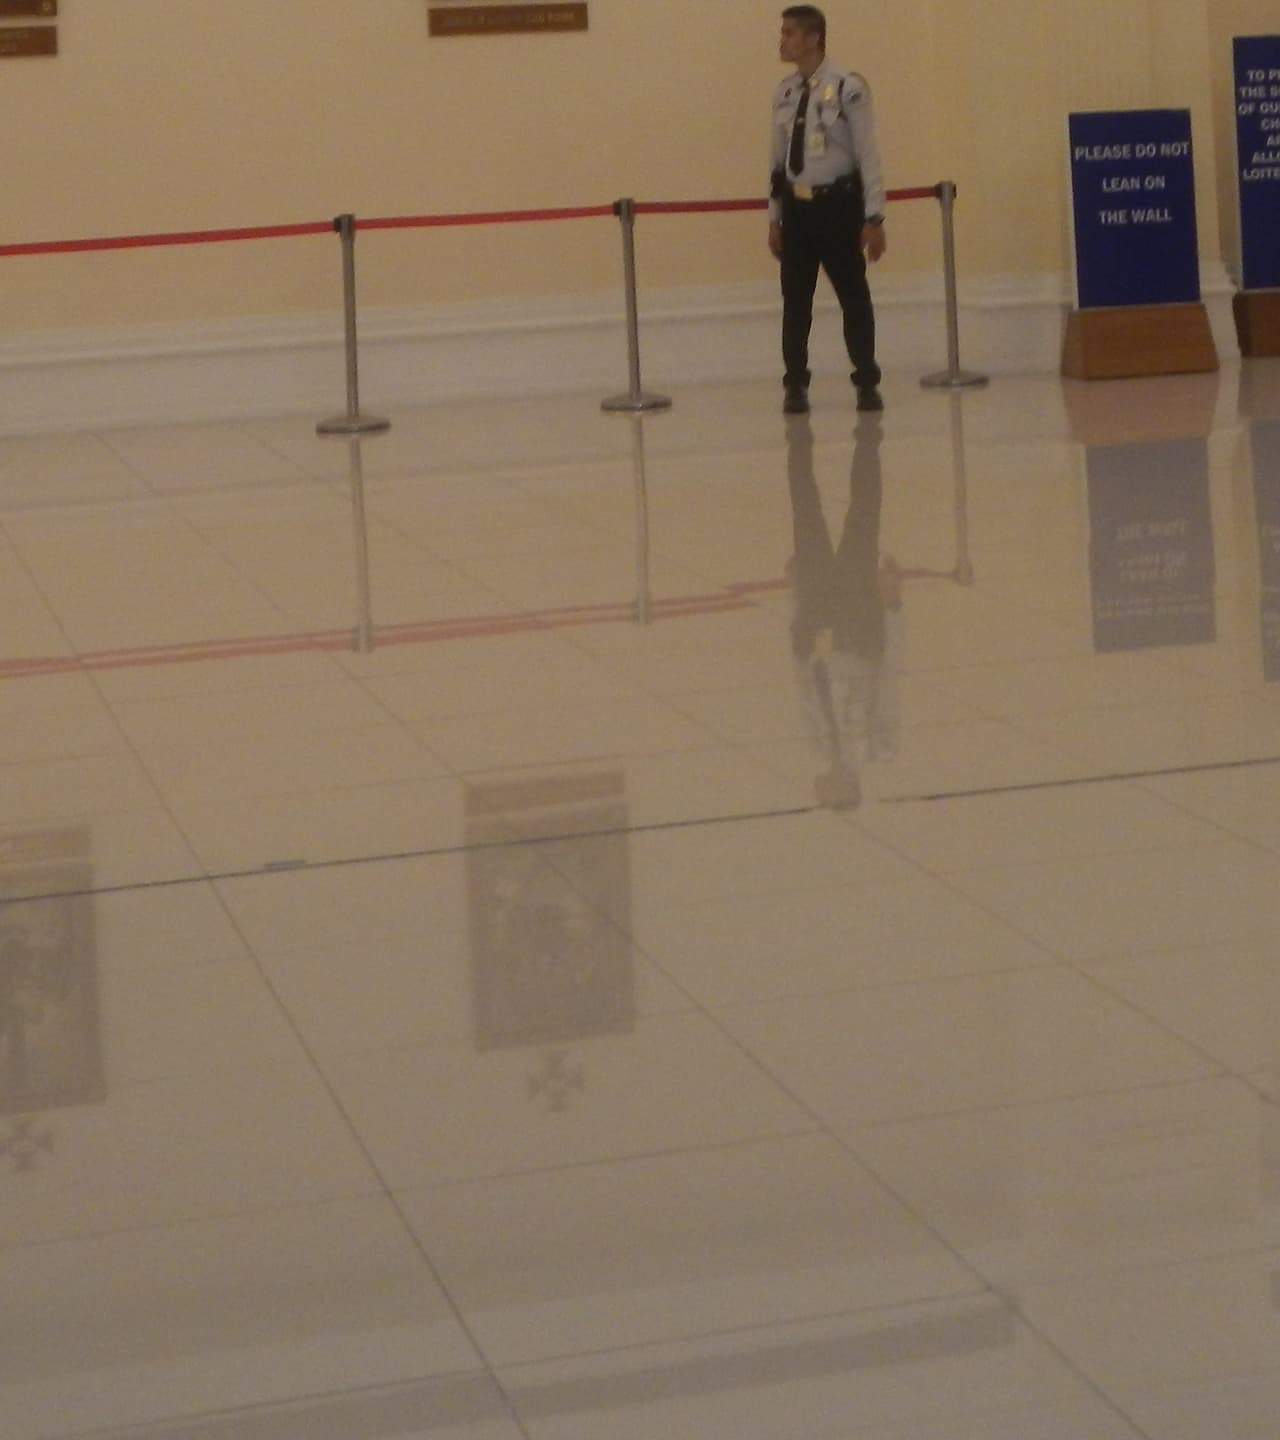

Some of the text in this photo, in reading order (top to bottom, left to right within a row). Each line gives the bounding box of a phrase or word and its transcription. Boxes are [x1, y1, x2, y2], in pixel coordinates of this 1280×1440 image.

[1247, 69, 1265, 82] TO
[1239, 85, 1266, 98] THE
[1237, 102, 1255, 115] OF
[1074, 141, 1190, 161] PLEASE DO NOT
[1102, 175, 1166, 193] LEAN ON
[1099, 207, 1172, 225] THE WALL
